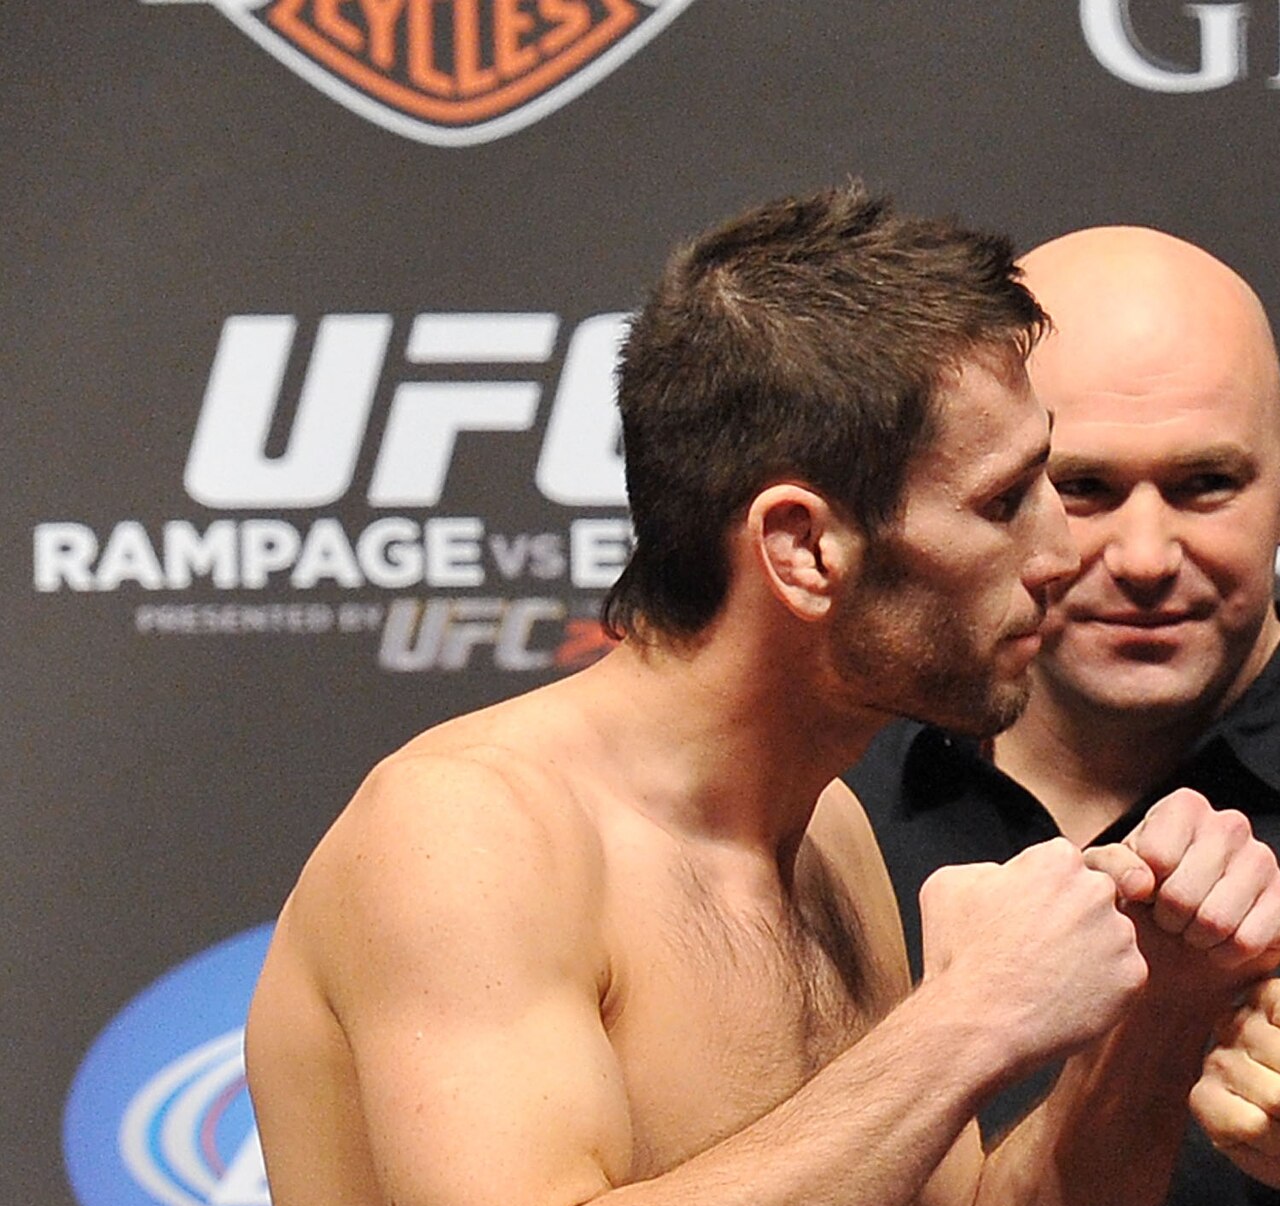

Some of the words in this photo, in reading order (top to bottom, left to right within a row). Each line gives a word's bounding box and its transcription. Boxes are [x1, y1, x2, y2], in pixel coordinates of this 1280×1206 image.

[32, 517, 486, 593] RAMPAGE
[491, 533, 567, 580] VS
[379, 598, 568, 673] UFC
